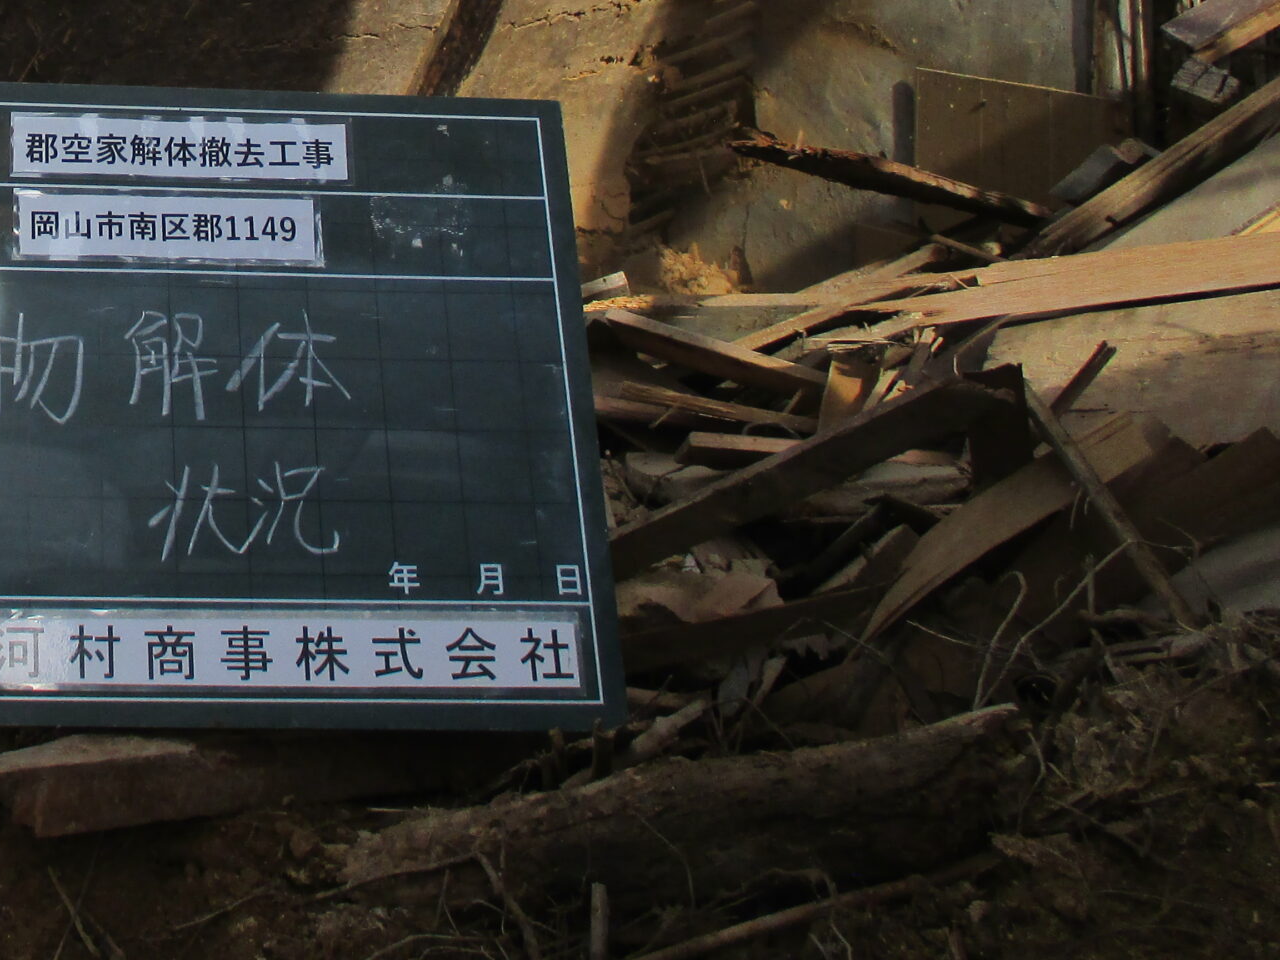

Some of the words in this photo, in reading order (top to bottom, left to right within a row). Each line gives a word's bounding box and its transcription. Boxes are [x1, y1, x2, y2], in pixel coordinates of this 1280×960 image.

[25, 132, 335, 170] 郡空家解体撤去工事
[30, 210, 297, 243] 岡山市南区郡1149
[148, 460, 341, 563] 状況
